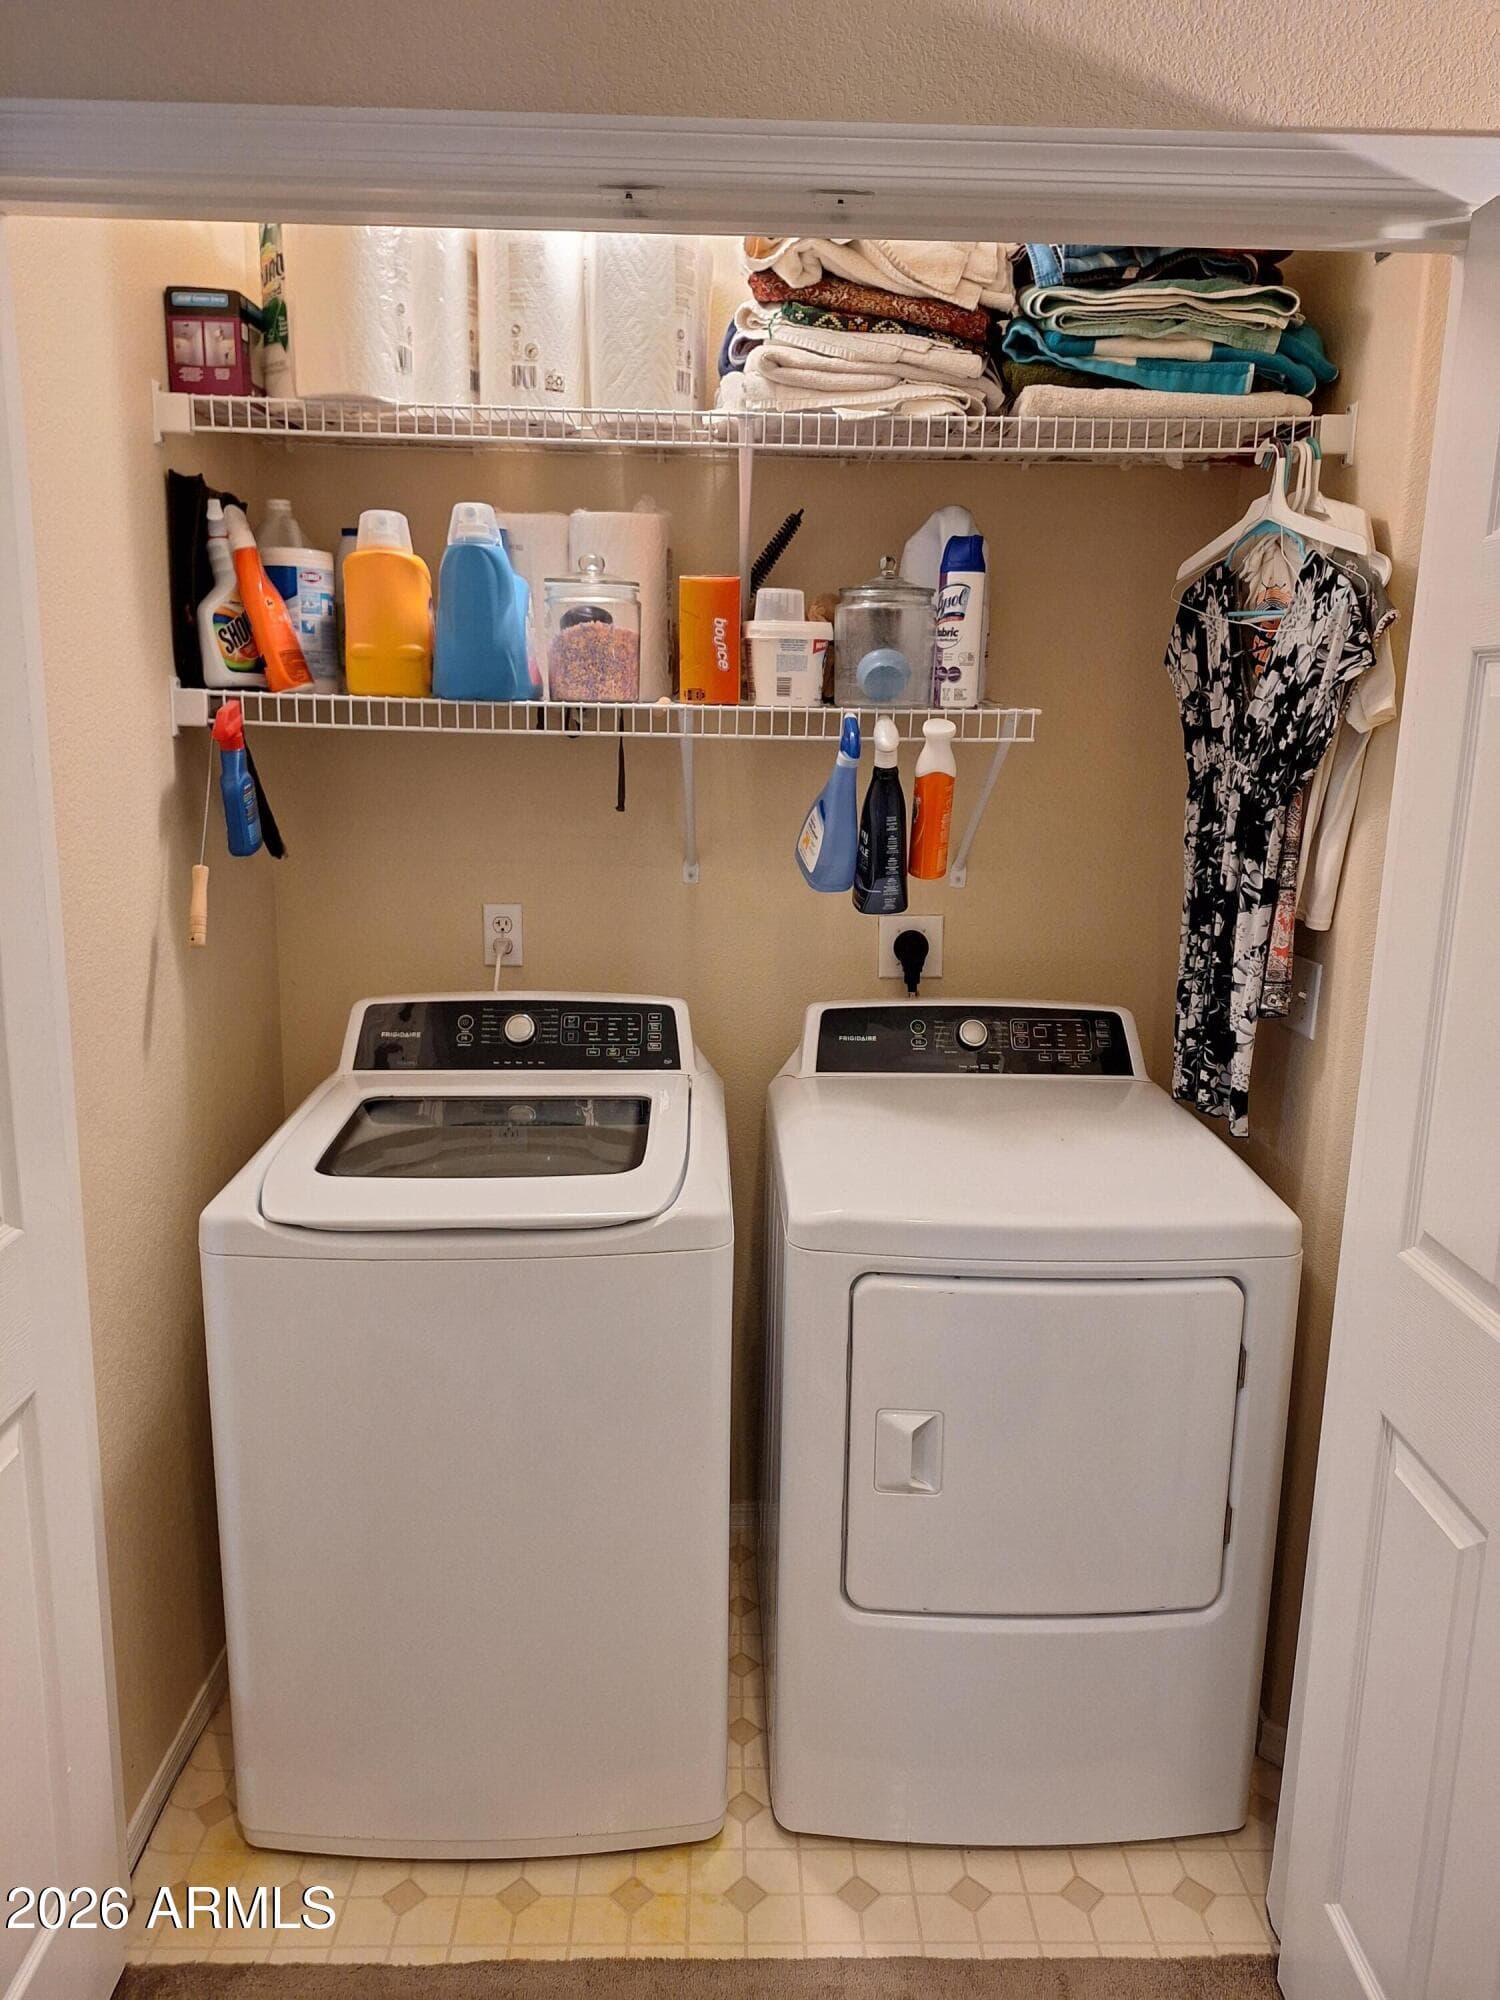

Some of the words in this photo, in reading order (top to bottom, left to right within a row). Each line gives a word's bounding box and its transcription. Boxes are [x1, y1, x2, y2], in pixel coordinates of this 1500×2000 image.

[218, 610, 252, 654] SHO
[713, 616, 730, 671] bounce
[936, 626, 959, 637] abric
